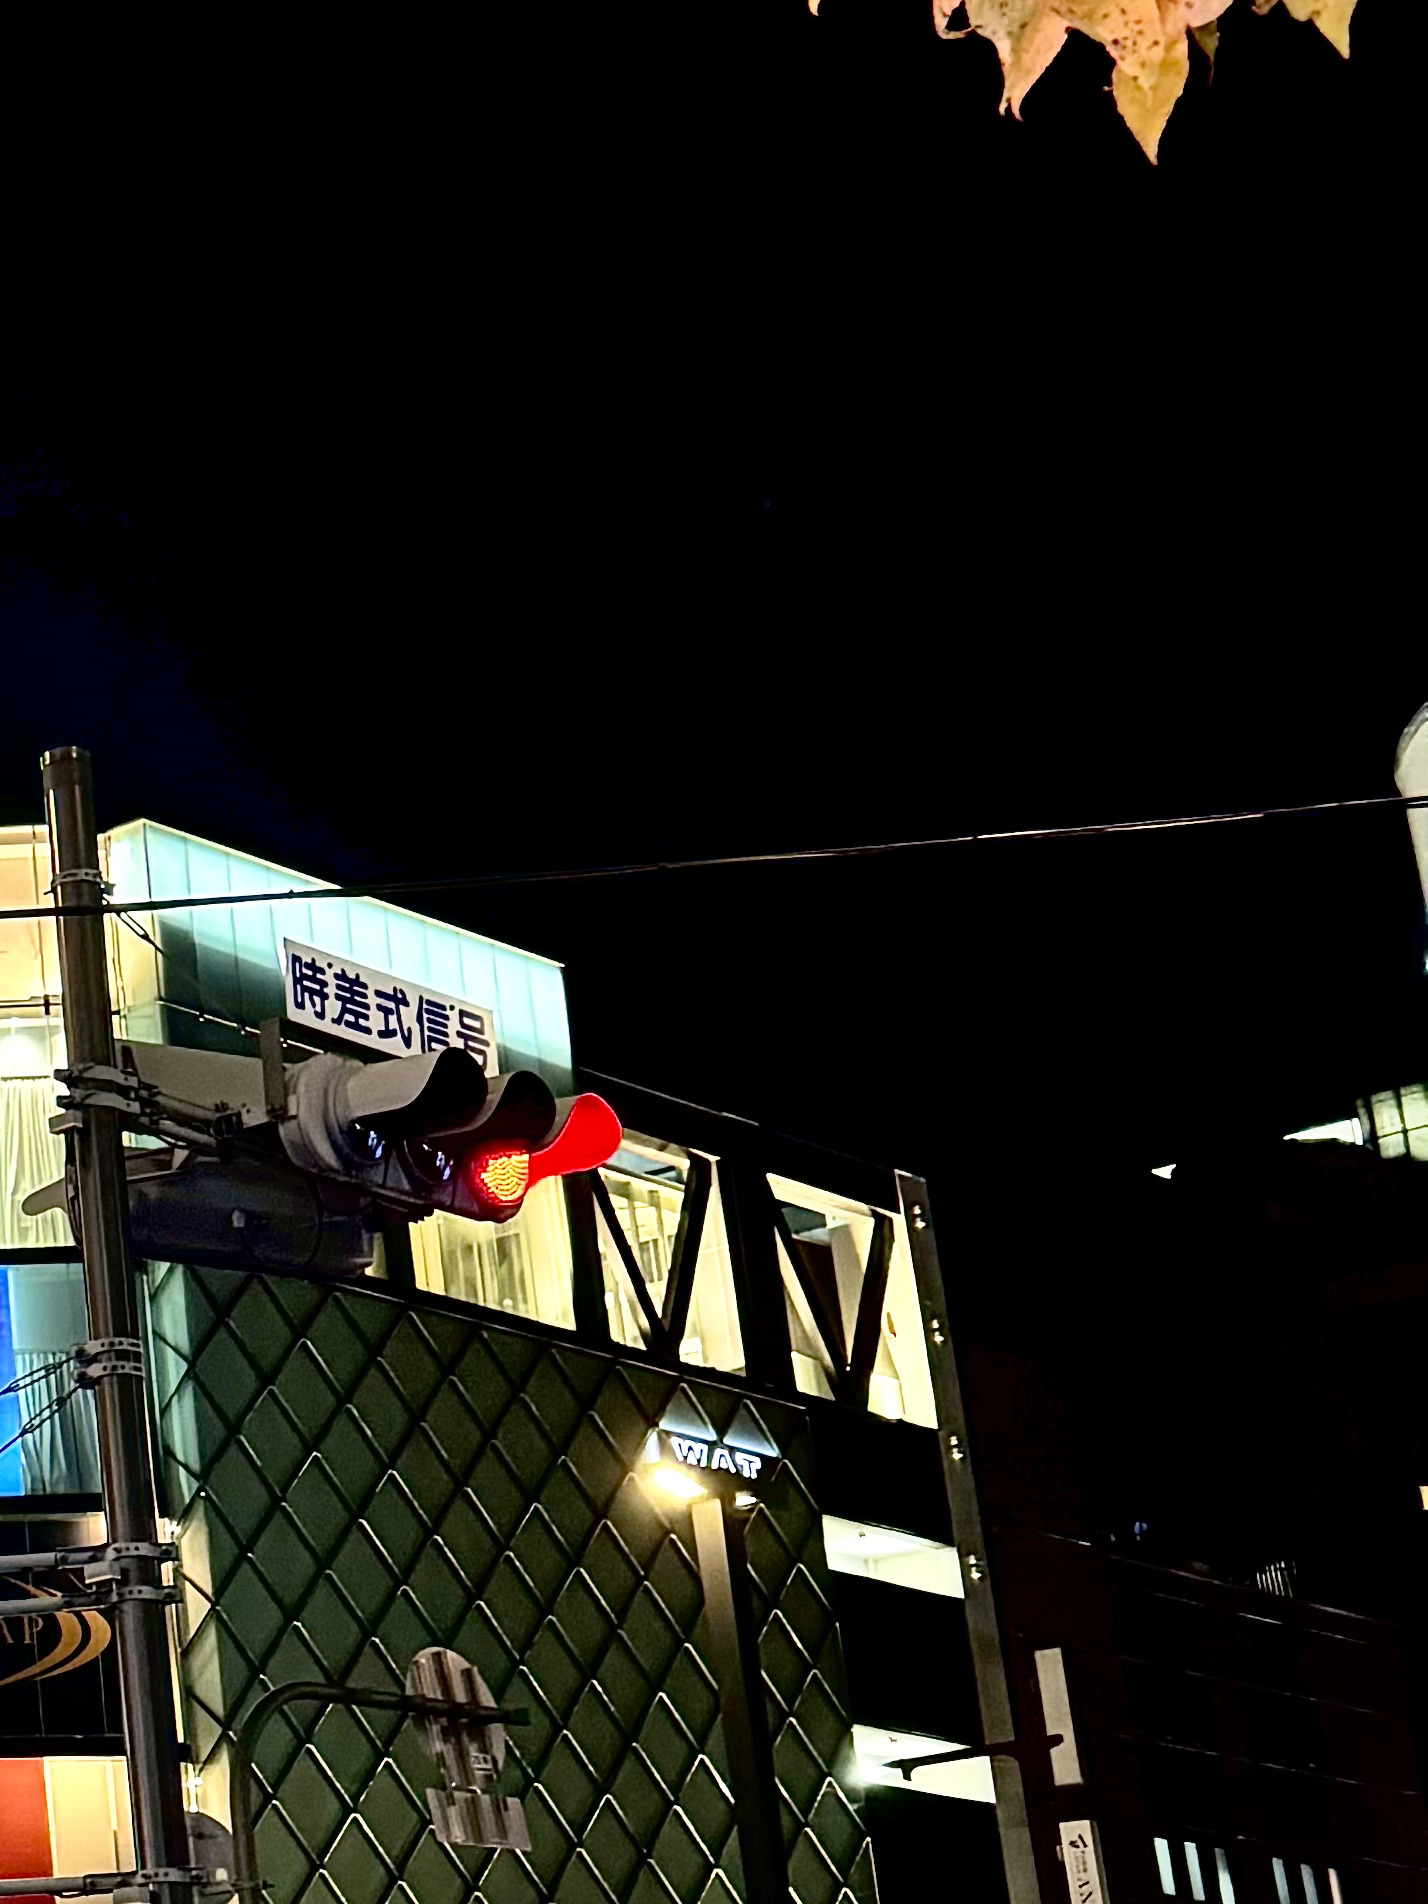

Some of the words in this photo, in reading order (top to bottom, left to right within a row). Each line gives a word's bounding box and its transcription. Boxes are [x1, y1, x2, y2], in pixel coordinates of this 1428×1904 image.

[291, 953, 491, 1072] 時差式信号
[670, 1436, 762, 1480] WAT
